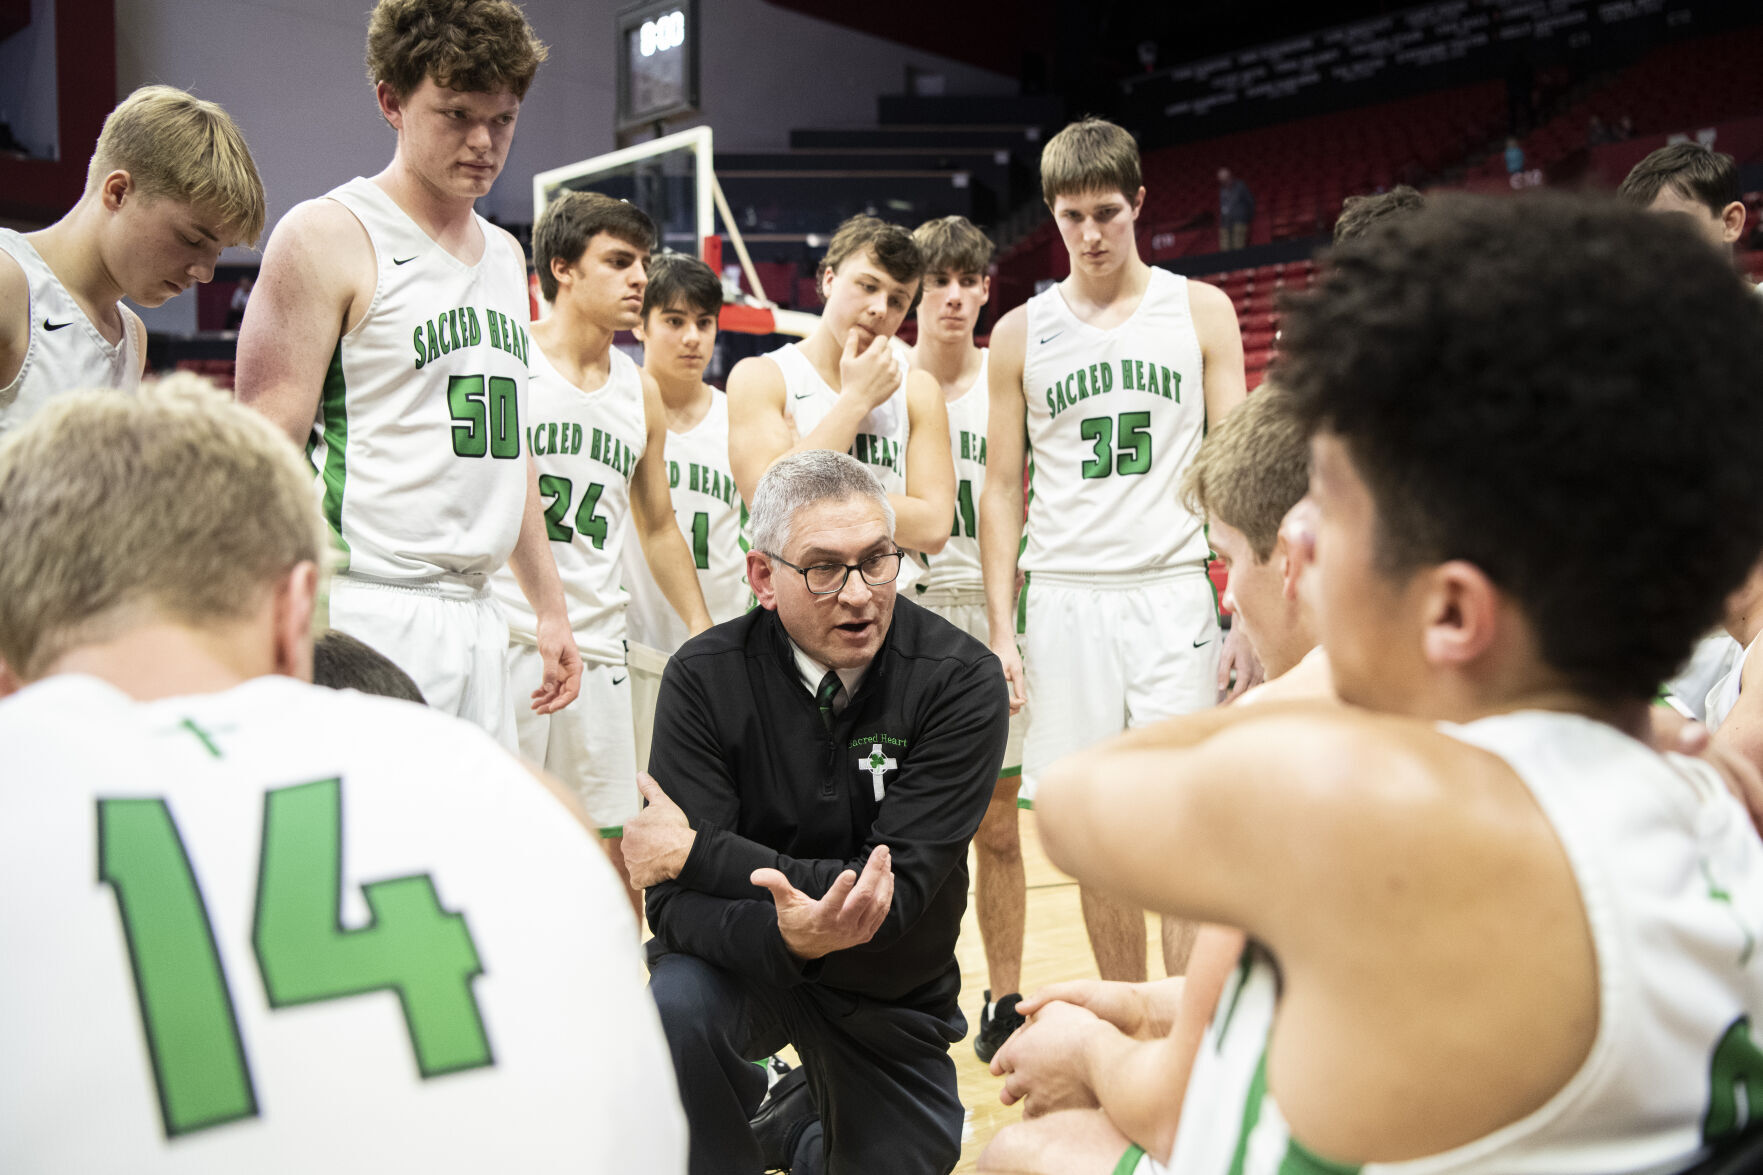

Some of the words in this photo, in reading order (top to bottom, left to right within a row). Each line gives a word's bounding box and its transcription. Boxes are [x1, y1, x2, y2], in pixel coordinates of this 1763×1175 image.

[414, 306, 482, 370] SACRED
[447, 374, 520, 460] 50
[1046, 361, 1113, 420] SACRED
[1121, 359, 1182, 405] HEART
[1080, 411, 1153, 480] 35
[538, 473, 609, 551] 24
[880, 733, 908, 748] Heart
[96, 776, 496, 1140] 14
